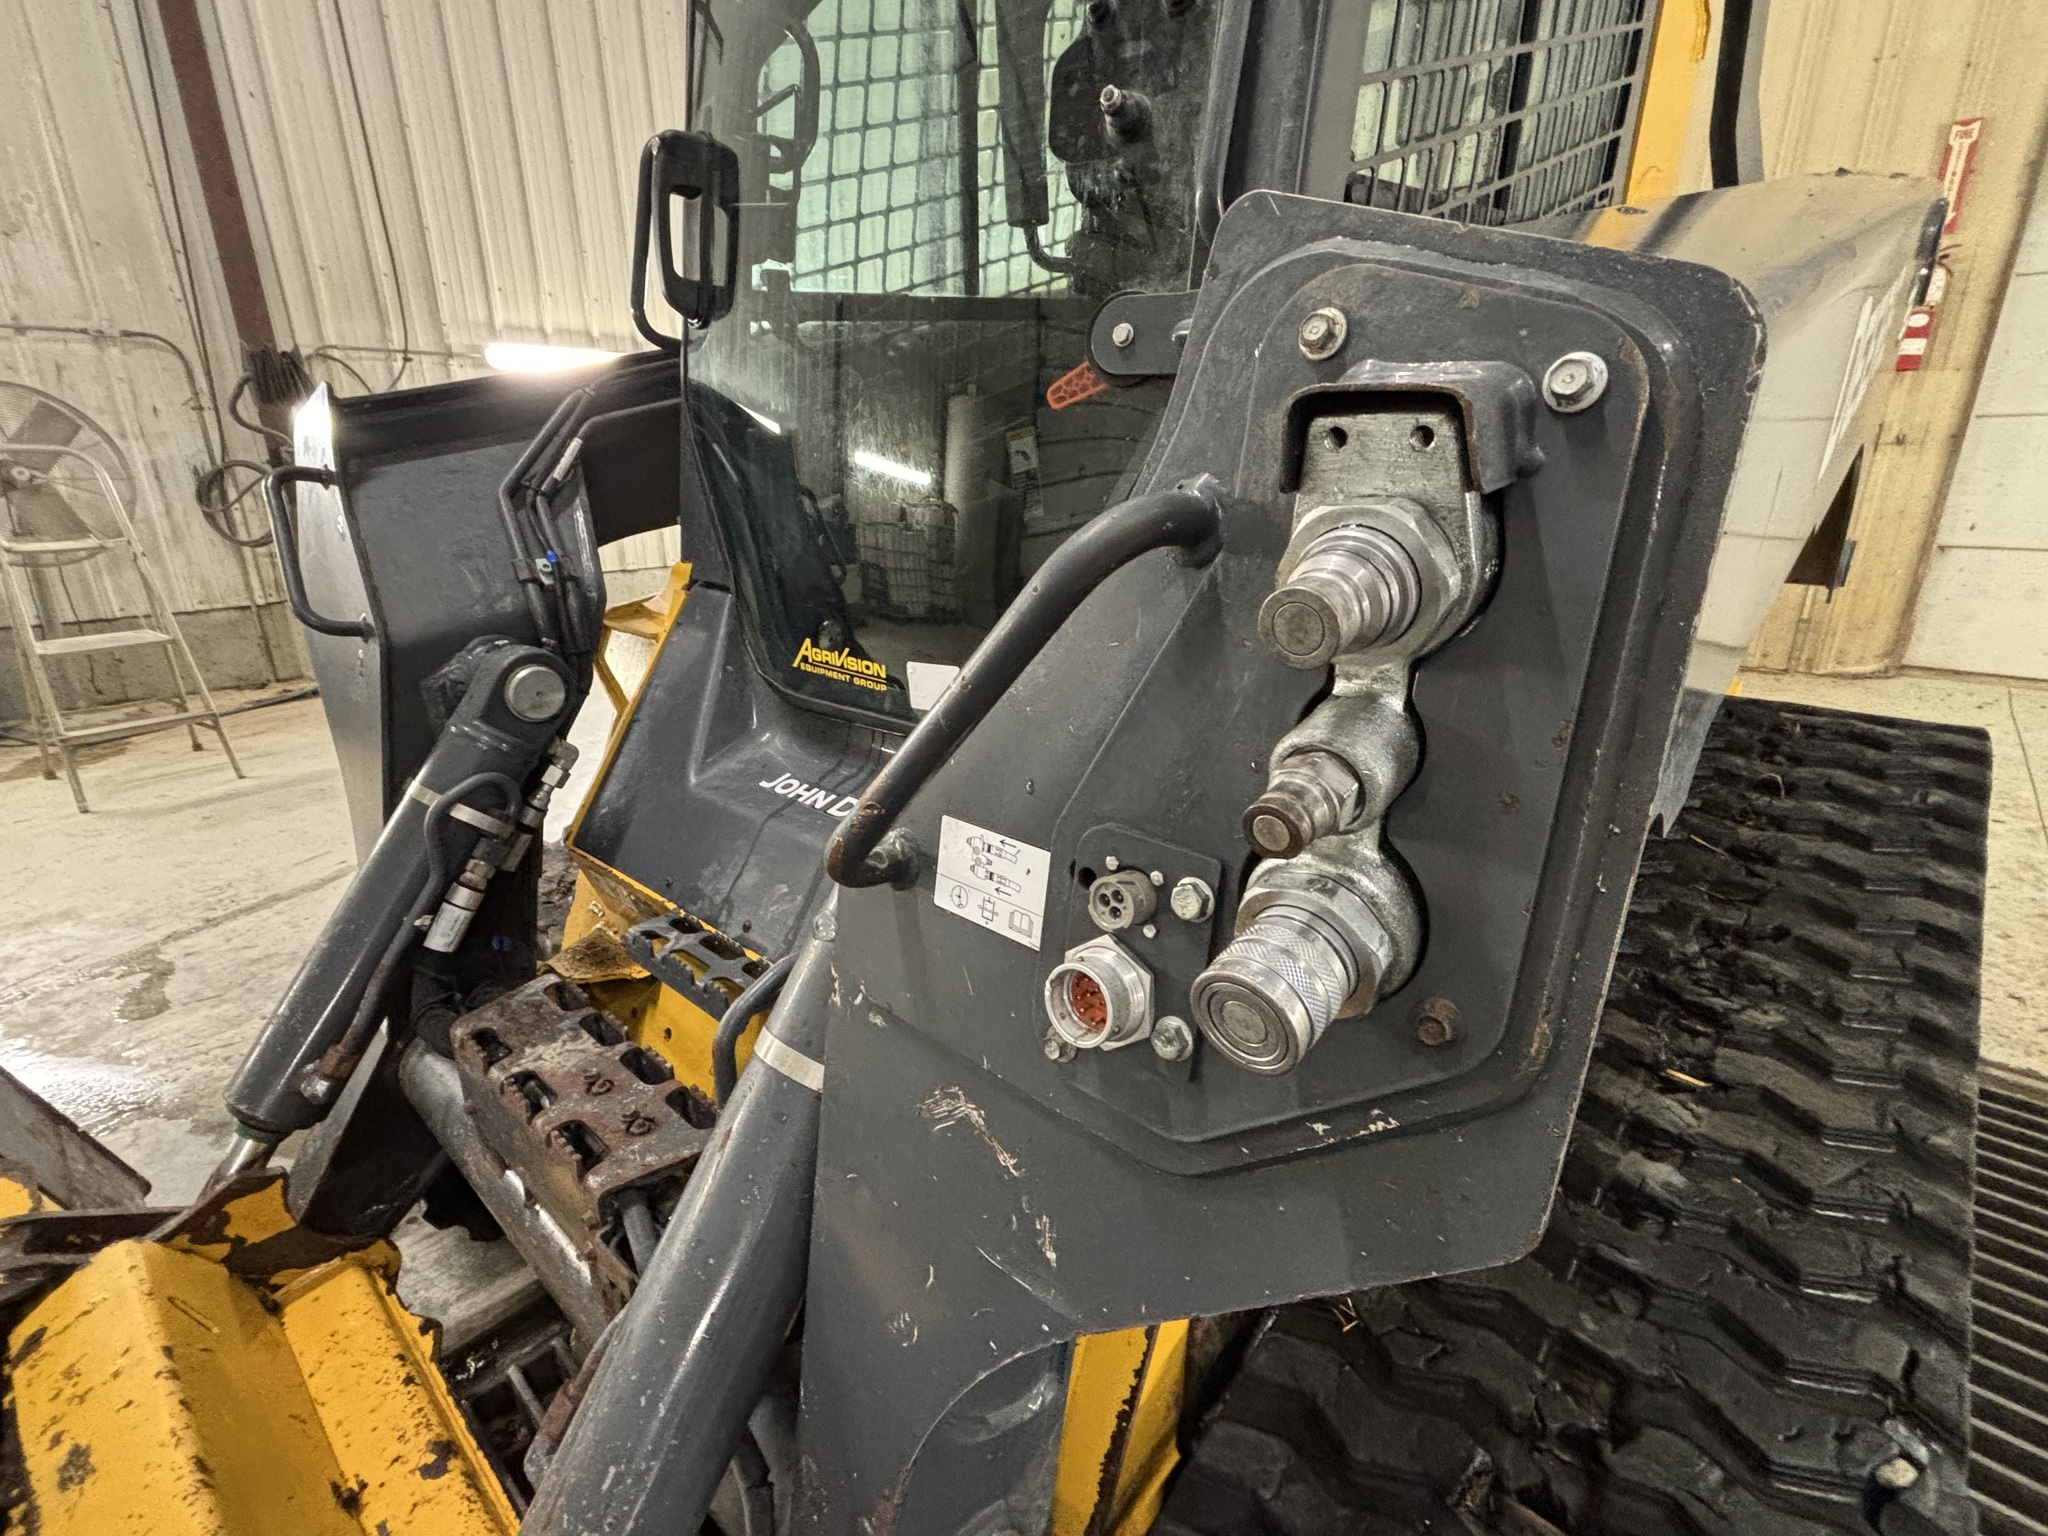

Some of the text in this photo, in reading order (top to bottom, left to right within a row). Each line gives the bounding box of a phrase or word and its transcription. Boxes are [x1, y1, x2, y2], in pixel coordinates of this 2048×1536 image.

[800, 663, 887, 691] EQUIPMENT GROUP
[759, 773, 837, 809] JOHN
